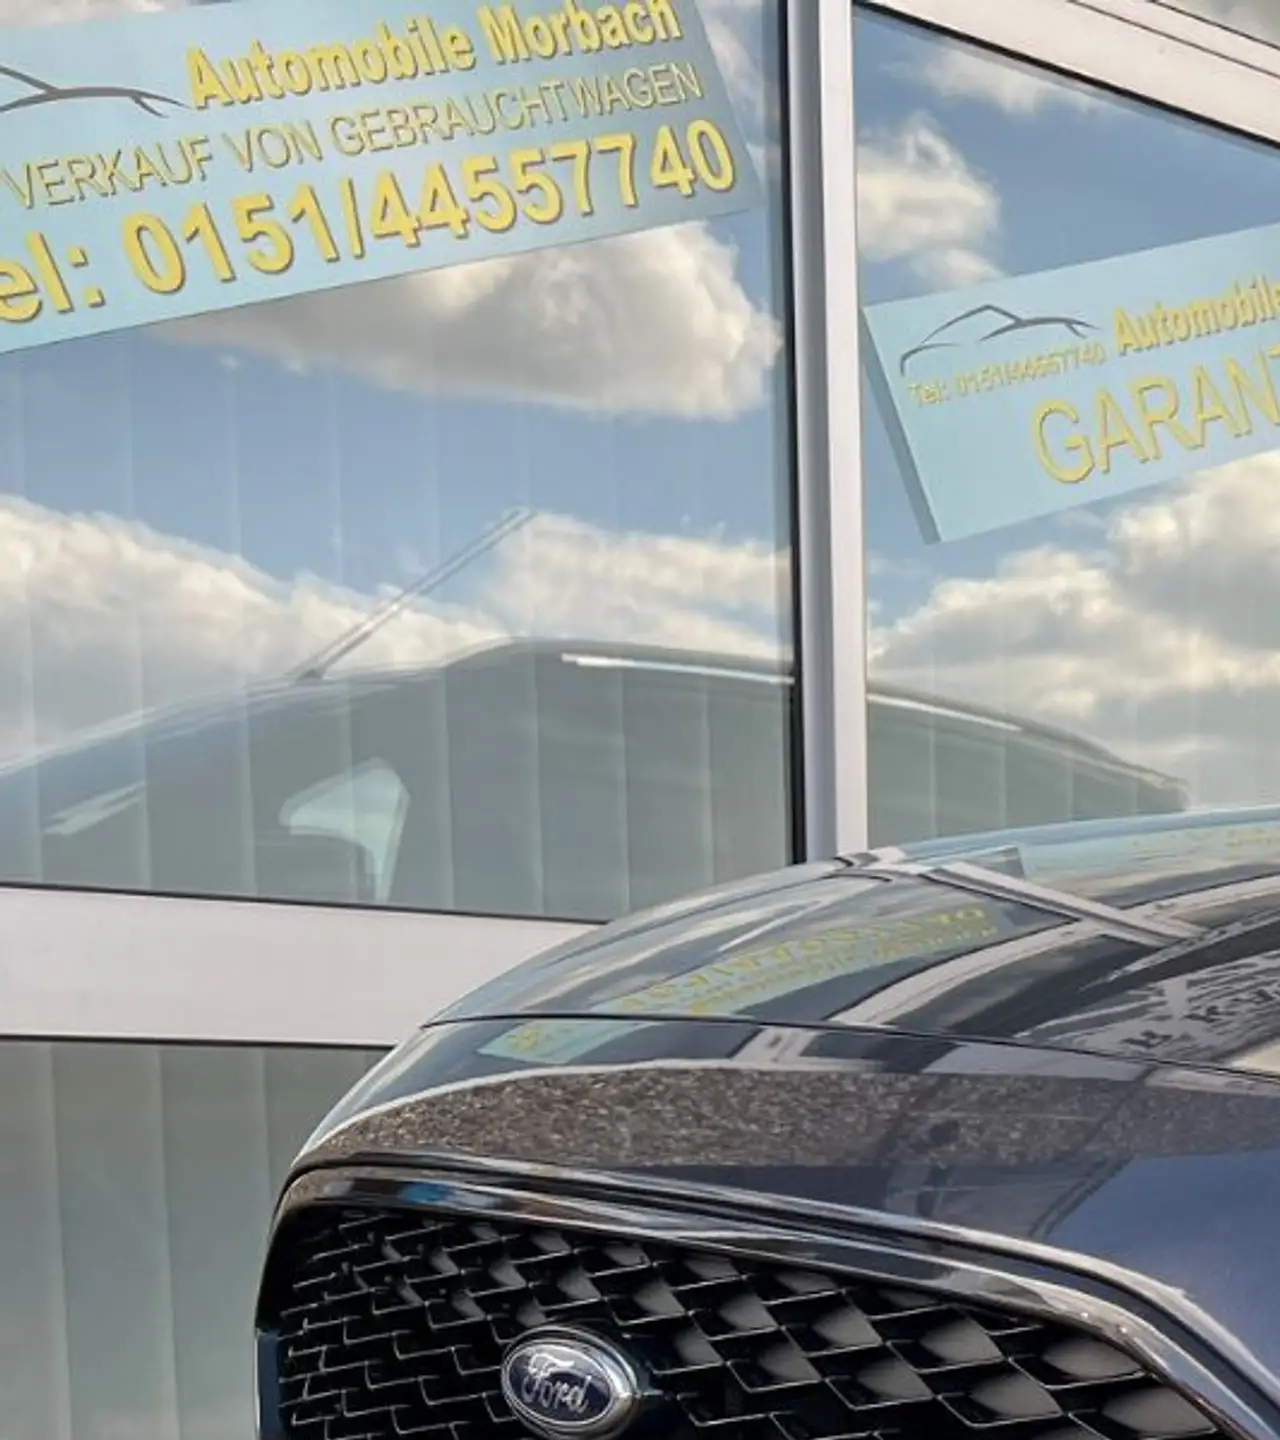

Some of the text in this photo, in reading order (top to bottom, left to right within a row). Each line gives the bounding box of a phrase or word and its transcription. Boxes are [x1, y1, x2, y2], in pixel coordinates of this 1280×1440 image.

[184, 0, 684, 109] Automobile Morbach
[1, 61, 703, 209] VERKAUF VON GEBRAUCHTWAGEN
[122, 119, 736, 294] 0151/44557740
[520, 1352, 594, 1414] Ford
